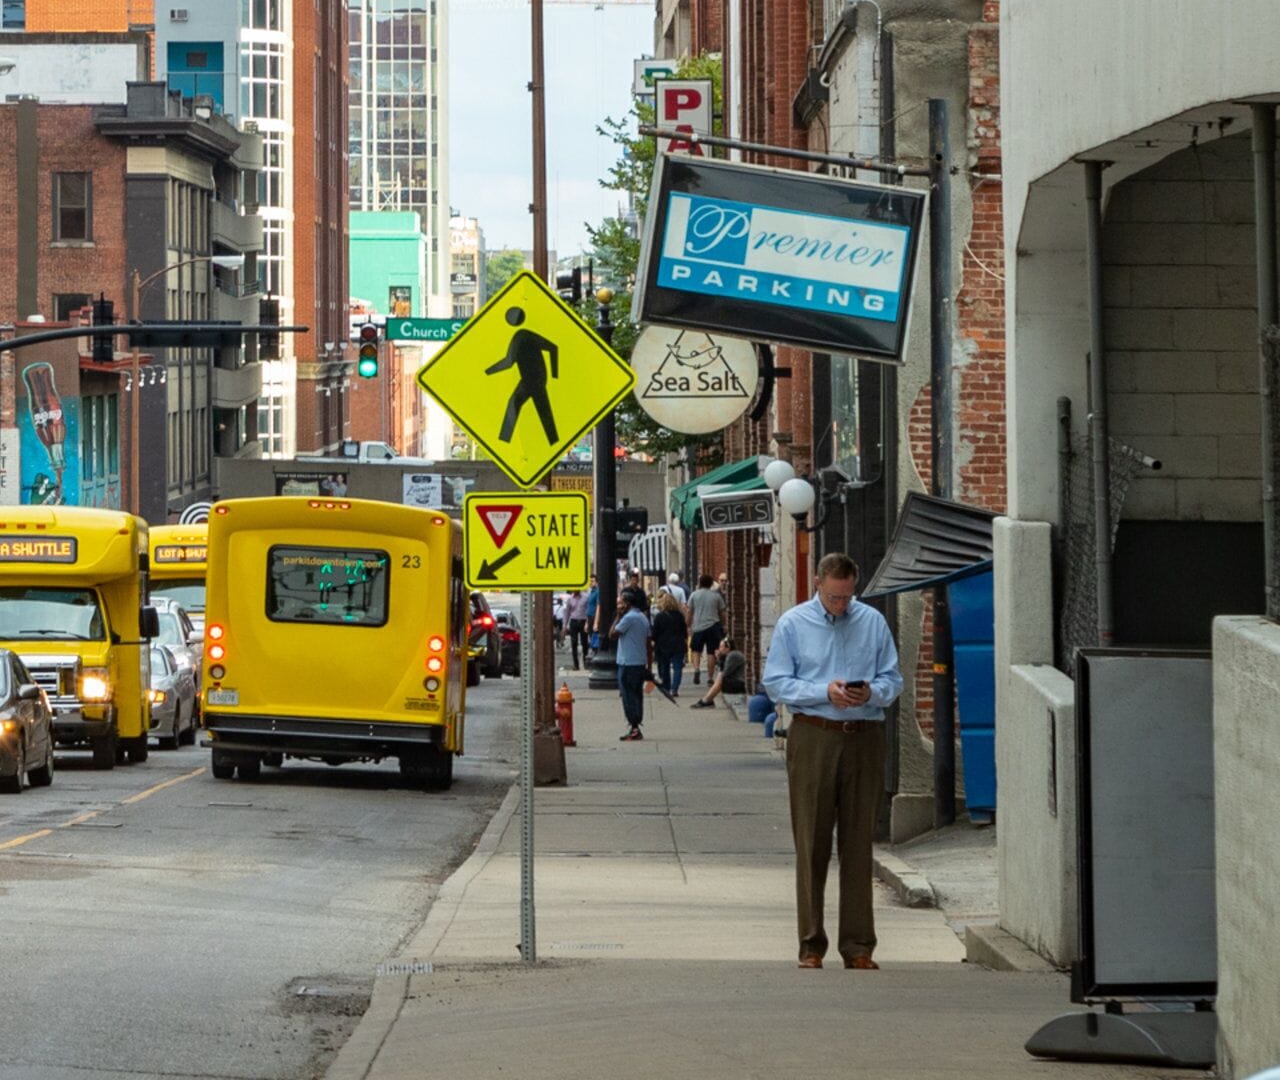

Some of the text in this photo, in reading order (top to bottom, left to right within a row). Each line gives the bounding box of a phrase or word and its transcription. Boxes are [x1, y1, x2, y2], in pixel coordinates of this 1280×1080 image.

[685, 203, 896, 269] Premier
[670, 264, 886, 313] PARKING
[400, 321, 448, 338] Church
[651, 370, 740, 392] Sea Salt
[709, 501, 769, 524] GIFTS
[526, 514, 581, 537] STATE
[0, 543, 10, 556] A
[12, 542, 72, 557] SHUTTLE
[159, 548, 177, 559] LOT
[535, 546, 572, 569] LAW
[401, 554, 422, 569] 23
